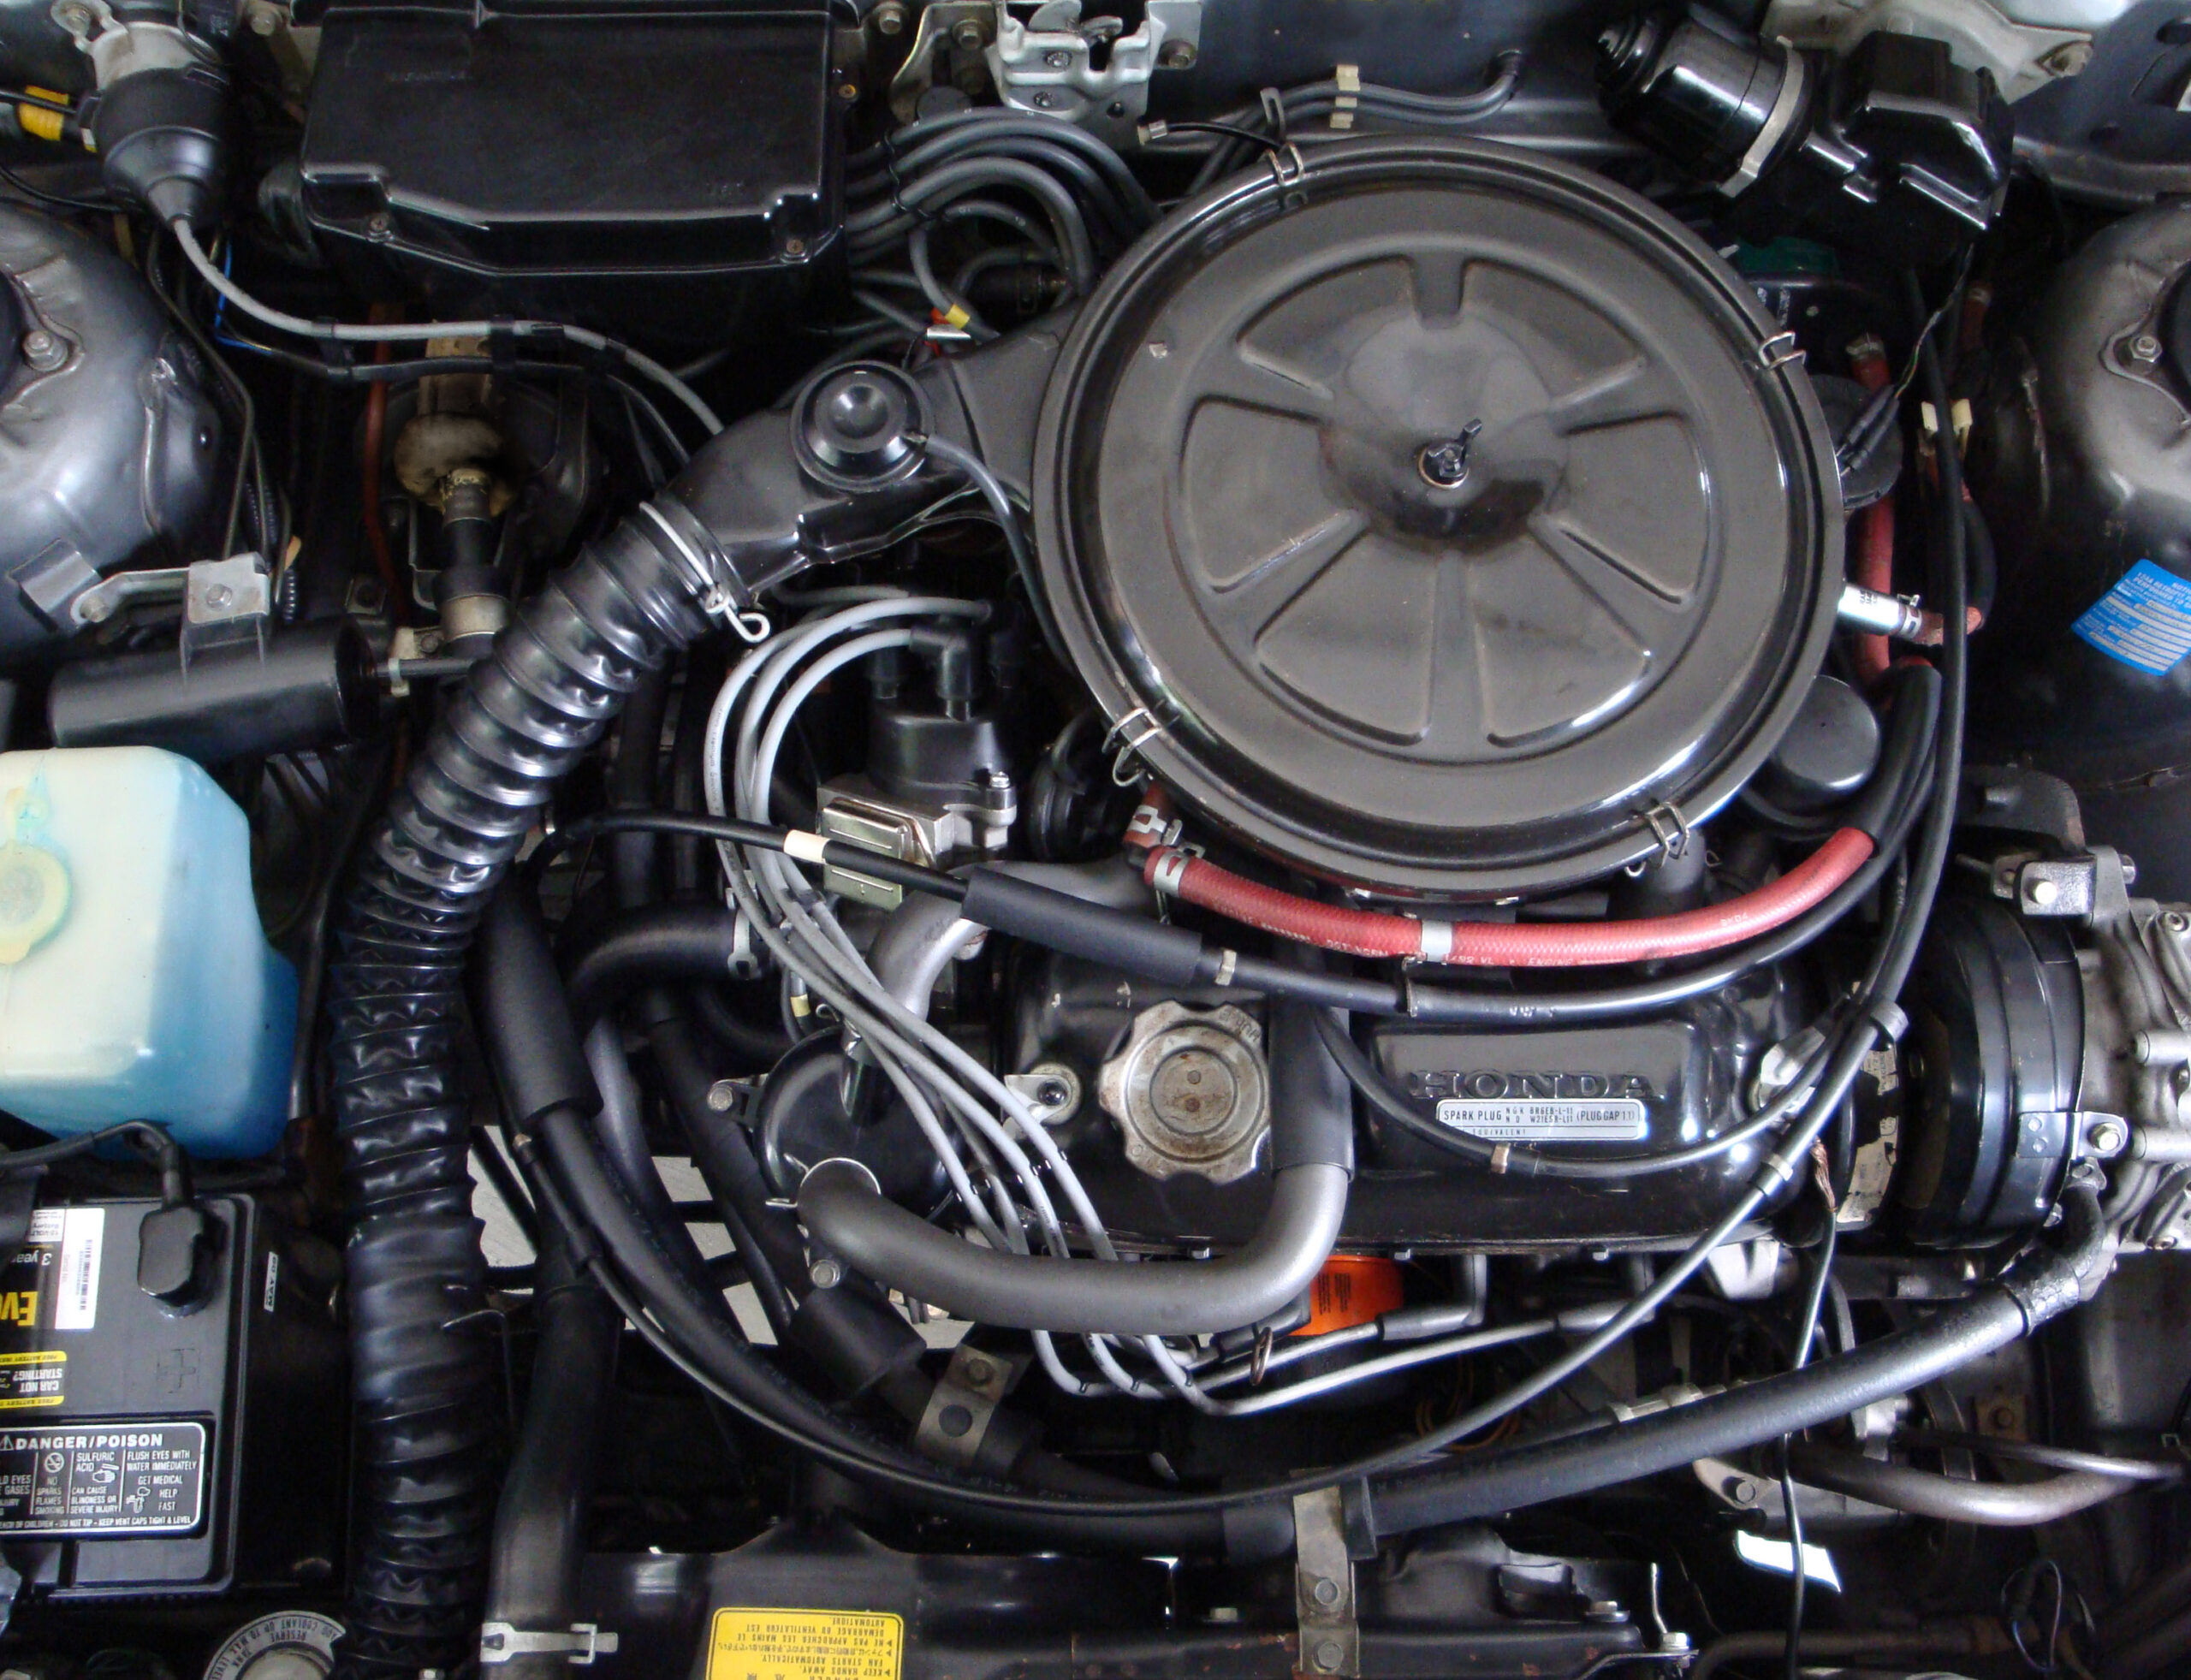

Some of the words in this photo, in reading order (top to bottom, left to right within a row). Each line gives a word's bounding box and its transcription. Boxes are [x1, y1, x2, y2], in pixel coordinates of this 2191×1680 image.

[1410, 1071, 1665, 1099] HONDA
[1444, 1110, 1474, 1120] SPARK
[1477, 1110, 1502, 1120] PLUG
[1603, 1111, 1619, 1120] GAP
[41, 1252, 52, 1266] 3
[13, 1368, 62, 1381] STARTING?
[19, 1381, 39, 1393] NOT
[39, 1380, 59, 1392] CAR
[15, 1434, 163, 1451] DANGER/POISON
[76, 1451, 115, 1462] SULFURIC
[128, 1451, 150, 1460] FLUSH
[151, 1451, 169, 1460] EYES
[172, 1450, 190, 1459] WITH
[75, 1463, 94, 1472] ACID
[127, 1462, 150, 1471] WATER
[151, 1461, 197, 1470] IMMEDIATELY
[11, 1475, 32, 1484] EYES
[47, 1476, 57, 1485] NO
[138, 1475, 151, 1485] GET
[153, 1475, 182, 1484] MEDICAL
[4, 1485, 30, 1495] GASES
[86, 1486, 107, 1494] CAUSE
[159, 1488, 177, 1498] HELP
[70, 1505, 94, 1514] SEVERE
[95, 1505, 118, 1513] INJURY
[158, 1502, 175, 1511] FAST
[766, 1624, 816, 1634] VENTILATEUR
[751, 1634, 776, 1642] MAINS
